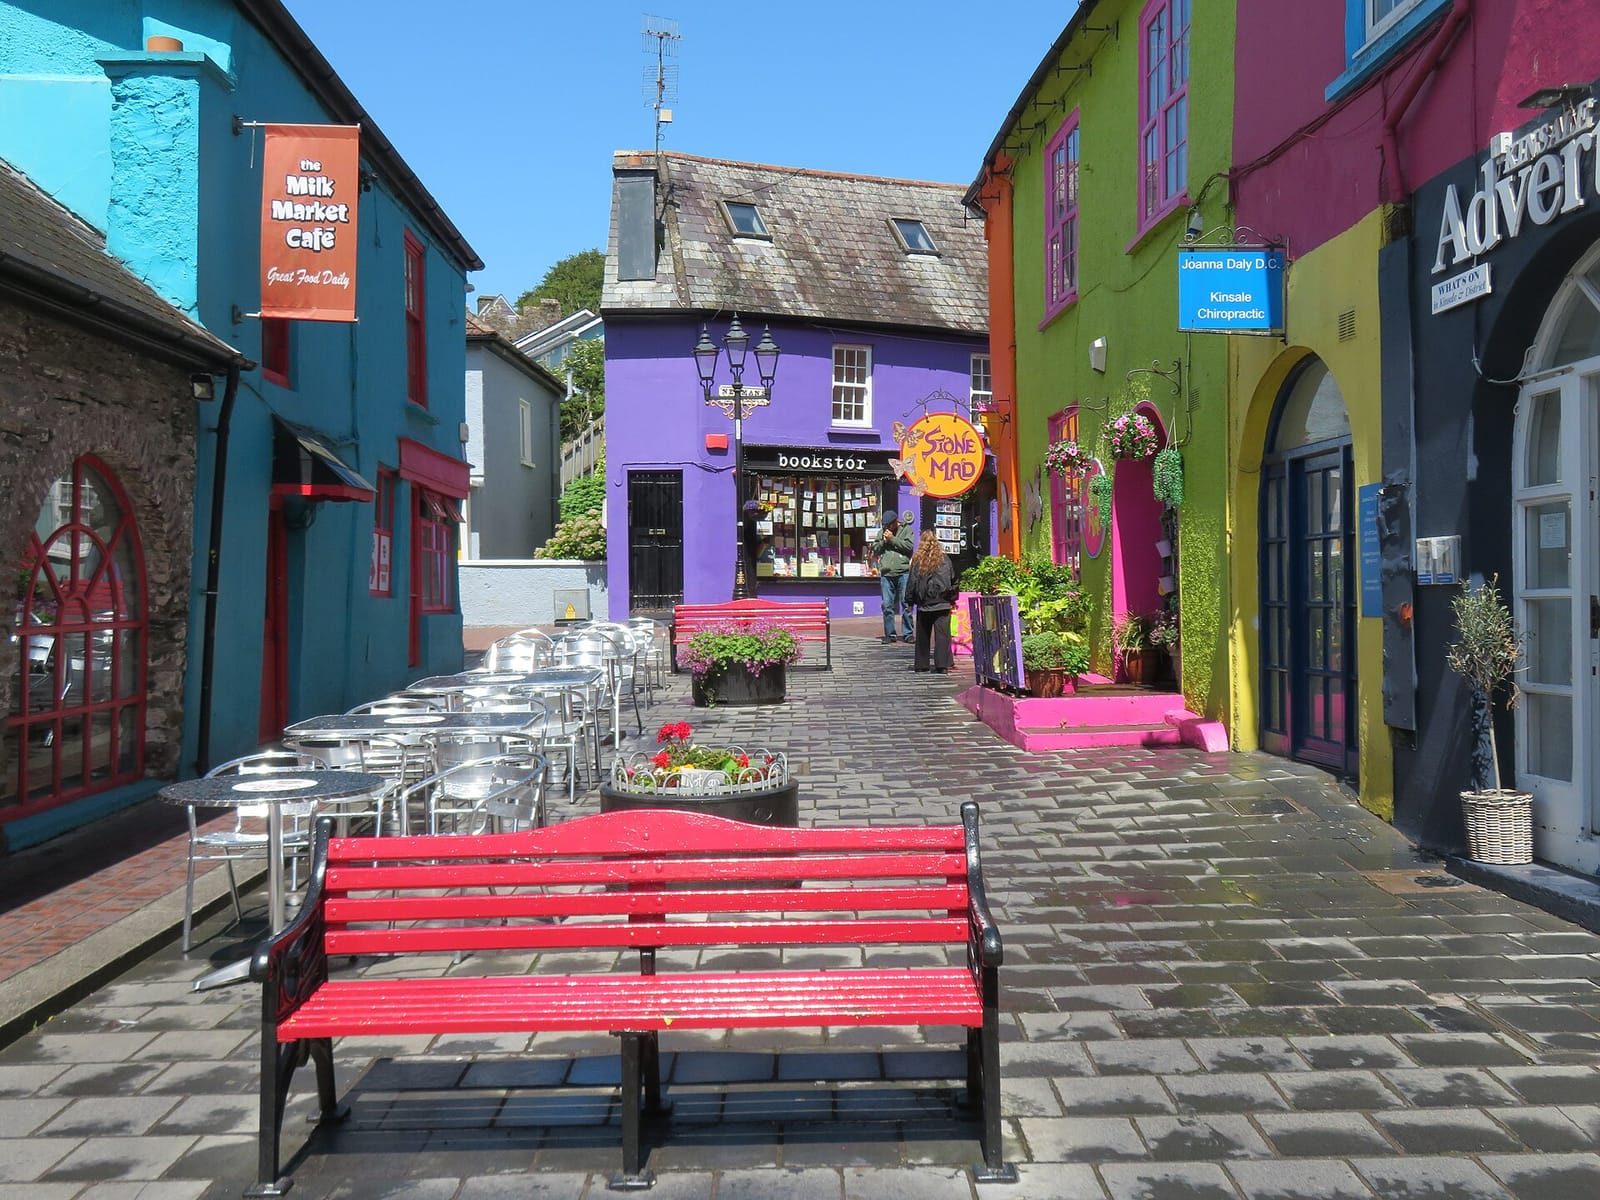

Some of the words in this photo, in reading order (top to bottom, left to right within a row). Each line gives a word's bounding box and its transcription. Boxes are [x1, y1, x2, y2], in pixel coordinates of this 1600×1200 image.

[300, 159, 321, 172] the
[286, 175, 335, 198] Milk
[271, 200, 349, 222] Market
[286, 227, 335, 251] Café
[1182, 259, 1223, 269] Joanna
[1226, 259, 1252, 271] Daly
[1255, 259, 1280, 269] D.C.
[1468, 270, 1480, 282] ON
[267, 267, 294, 286] Great
[296, 269, 320, 285] Food
[322, 271, 350, 289] Daily
[1210, 292, 1252, 302] Kinsale
[1197, 308, 1265, 320] Chiropractic
[922, 425, 977, 462] STONE
[929, 457, 976, 481] MAD
